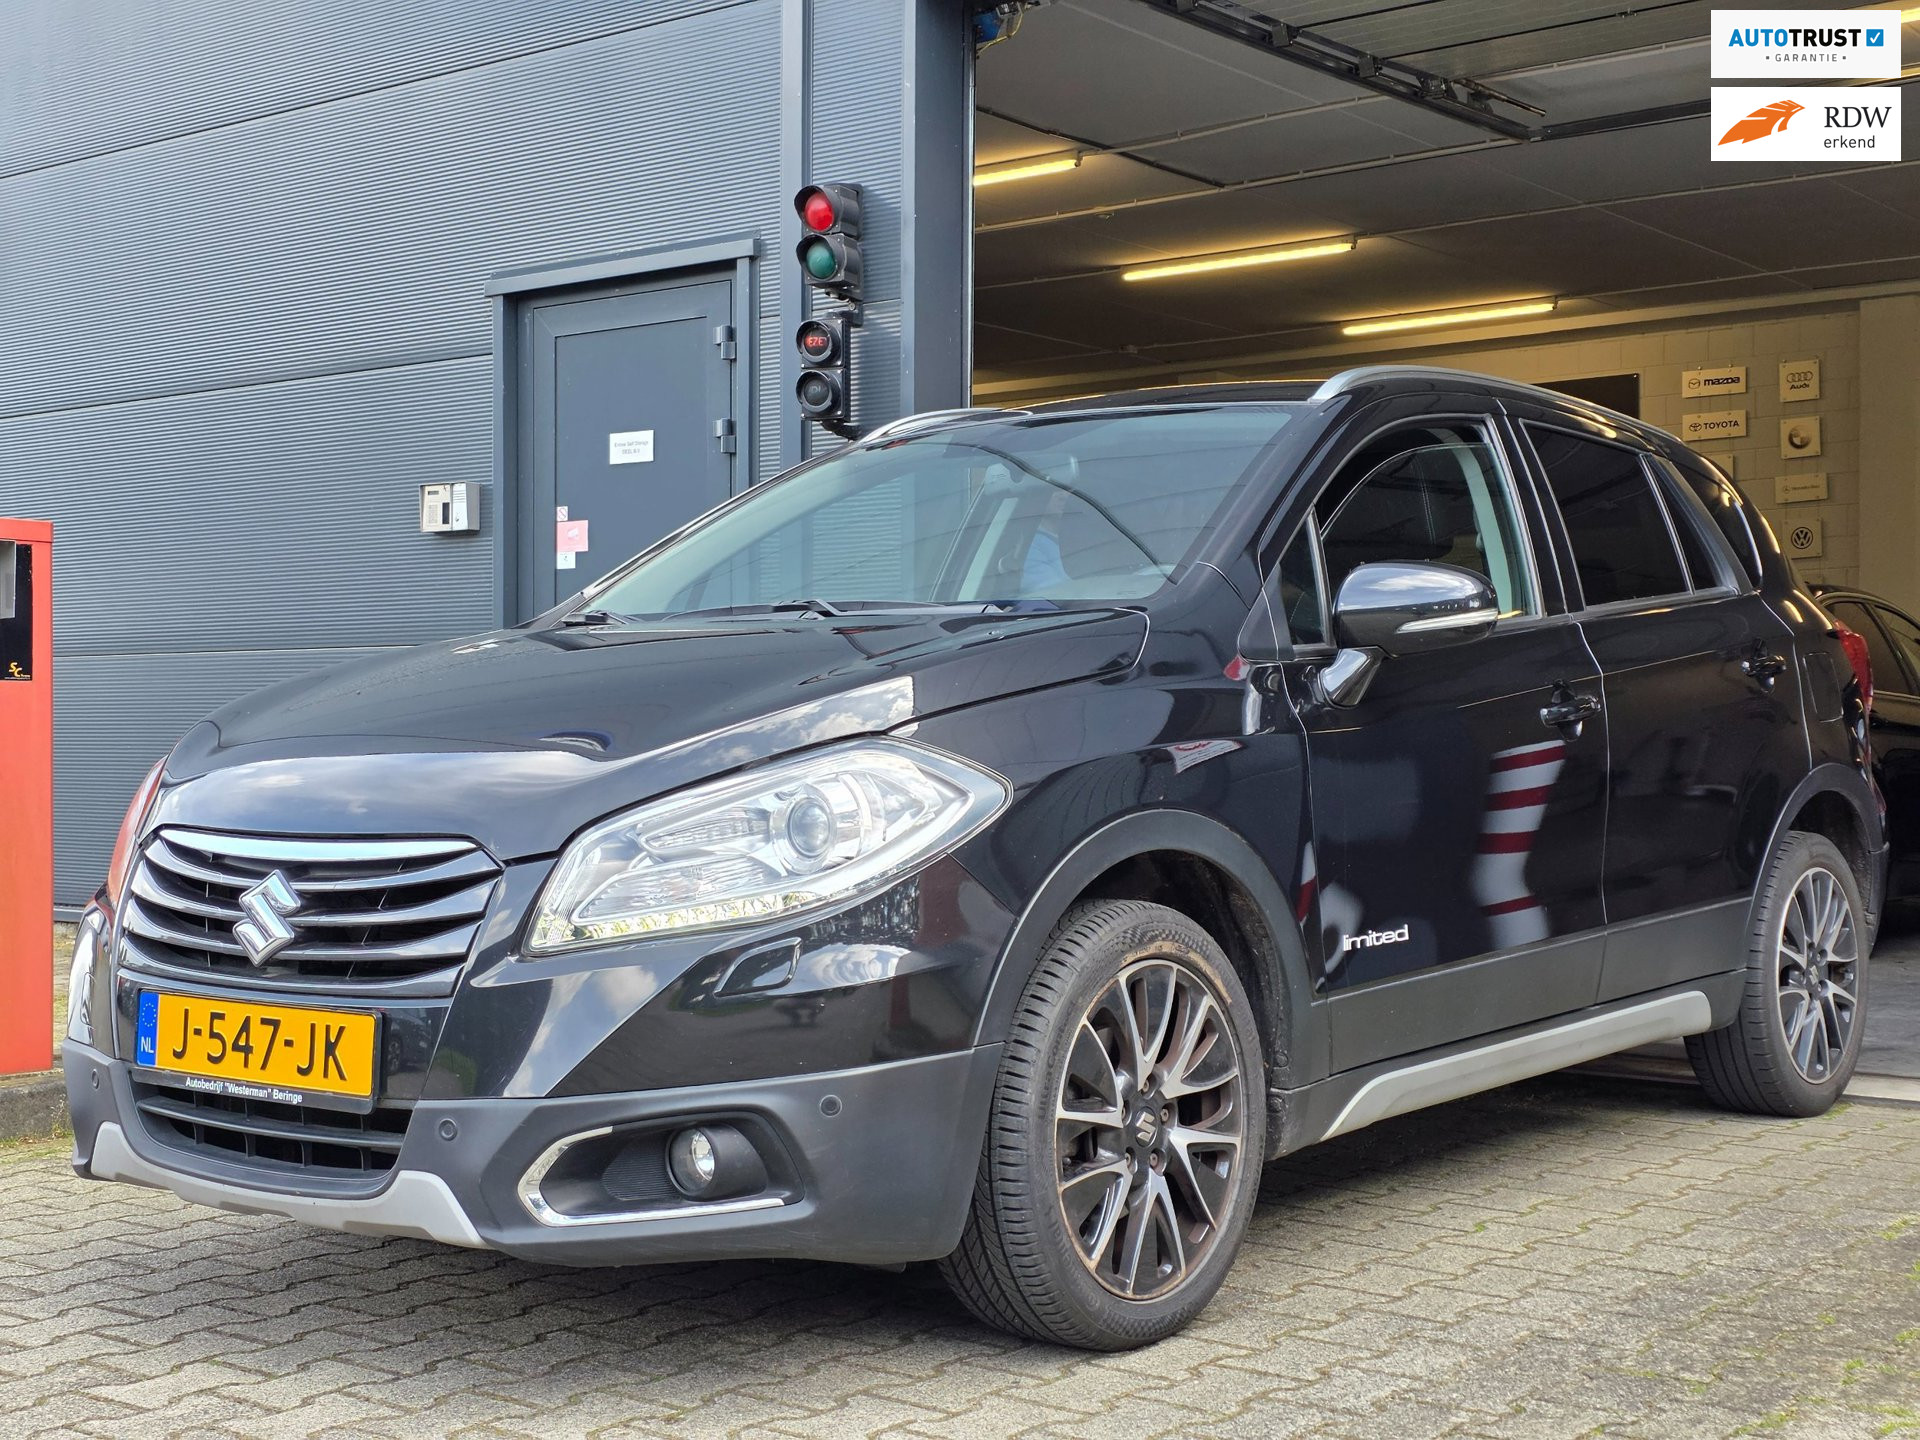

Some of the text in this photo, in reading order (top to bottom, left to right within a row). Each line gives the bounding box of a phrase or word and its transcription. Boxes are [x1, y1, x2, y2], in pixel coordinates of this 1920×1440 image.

[1703, 420, 1740, 430] TOYOTA
[1343, 923, 1410, 952] limited
[140, 1036, 155, 1054] NL
[172, 1008, 348, 1082] J-547-JK
[185, 1076, 303, 1104] Autobedrijf "Westerman" Beringe
